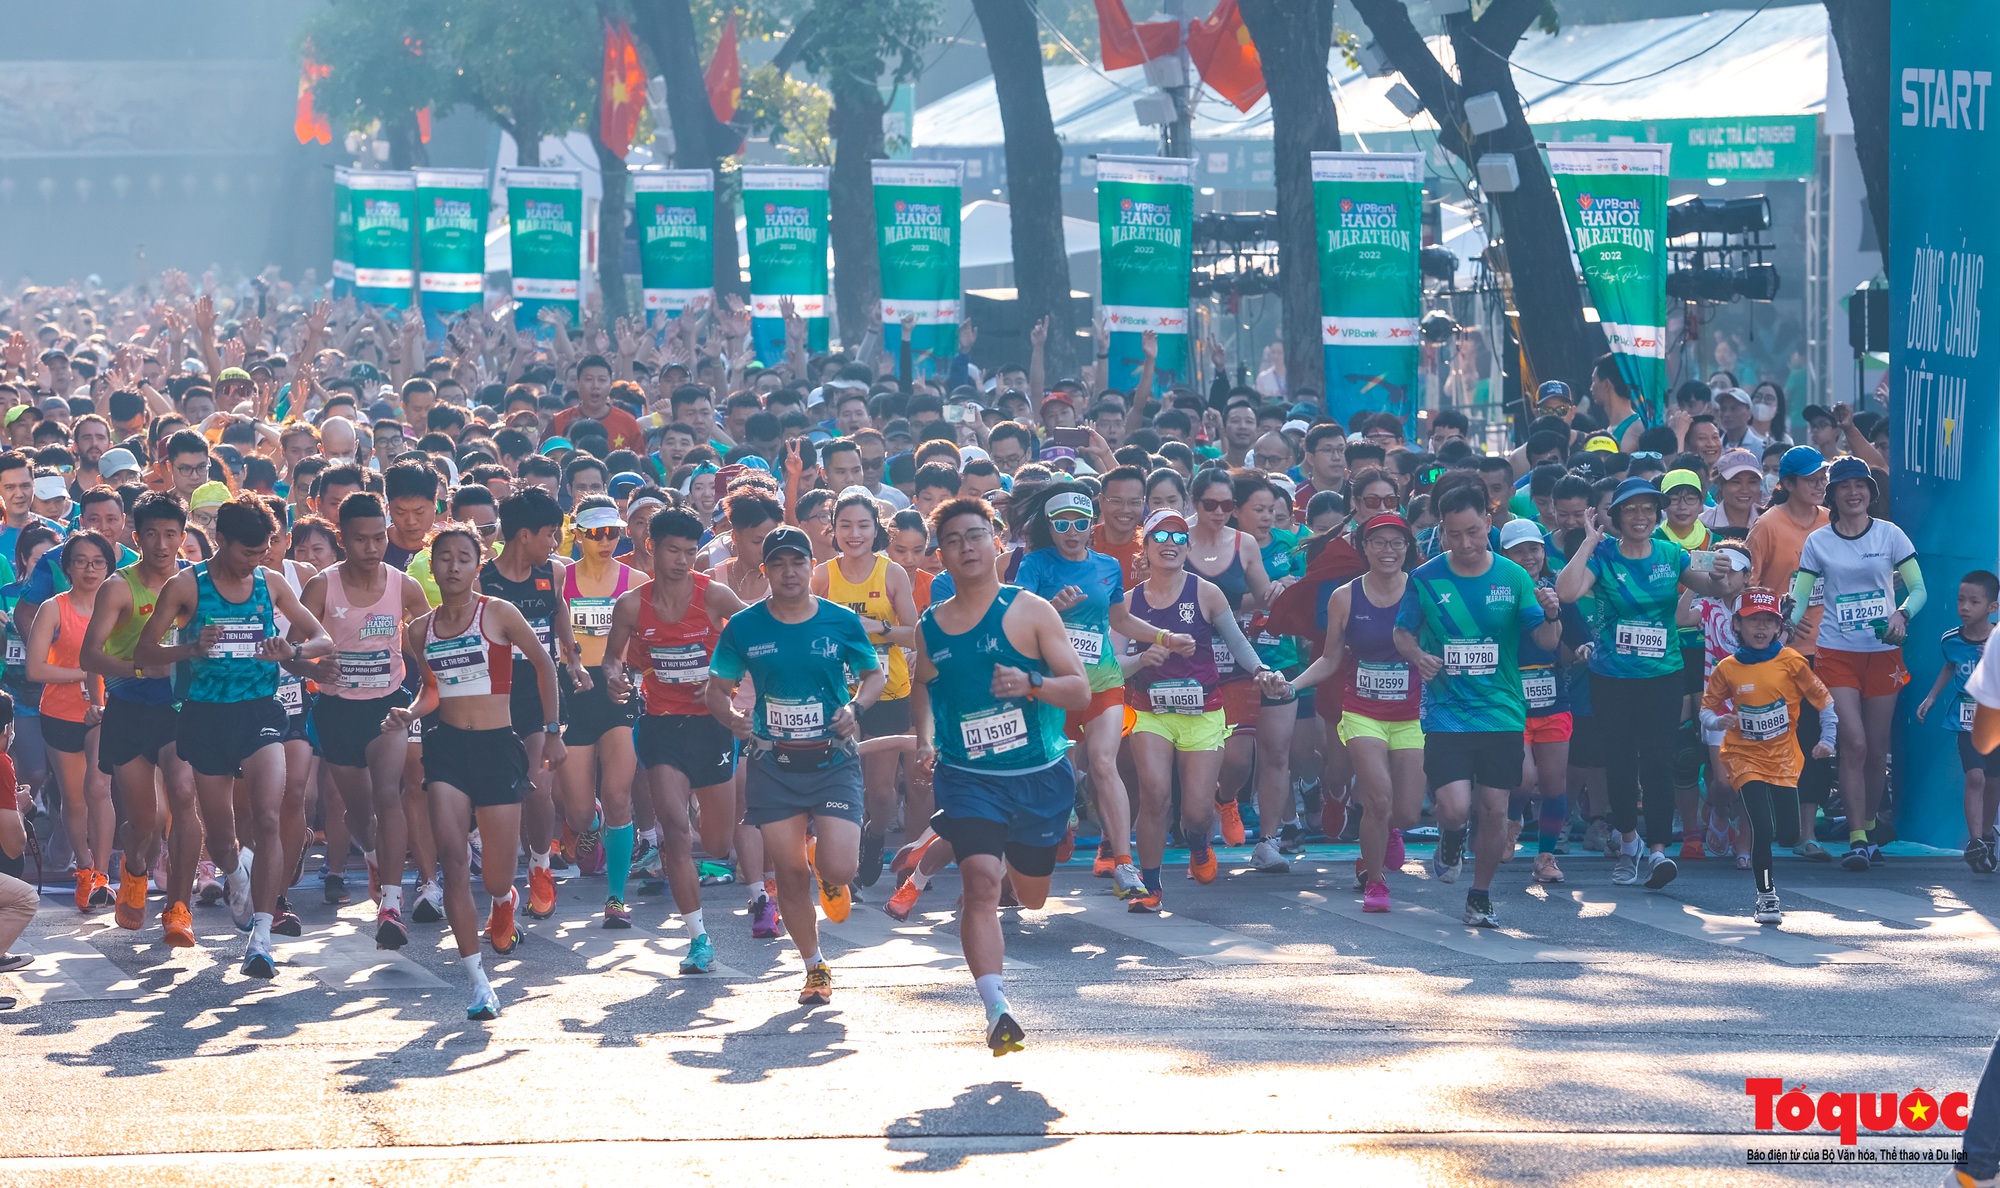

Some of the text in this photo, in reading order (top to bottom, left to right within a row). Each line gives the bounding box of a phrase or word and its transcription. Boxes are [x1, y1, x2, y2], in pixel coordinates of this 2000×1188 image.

[1901, 68, 1992, 130] START
[1134, 203, 1171, 212] VPBank
[1356, 204, 1397, 213] VPBank
[1595, 199, 1640, 210] VPBank
[526, 208, 564, 219] HANOI
[656, 213, 697, 225] HANOI
[895, 212, 942, 225] HANOI
[1120, 211, 1171, 226] HANOI
[1580, 210, 1640, 226] HANOI
[765, 214, 809, 226] HANOI
[1341, 213, 1397, 228] HANOI
[516, 218, 573, 237] MARATHON
[647, 225, 707, 243] MARATHON
[755, 227, 817, 246] MARATHON
[884, 226, 951, 246] MARATHON
[1111, 226, 1182, 248] MARATHON
[1328, 229, 1410, 253] MARATHON
[911, 244, 929, 252] 2022
[1134, 246, 1154, 254] 2022
[1359, 251, 1381, 259] 2022
[1600, 251, 1622, 260] 2022
[1945, 237, 1984, 358] SÁNG
[1341, 329, 1377, 338] VPBank
[1905, 358, 1933, 485] VIỆT
[1749, 593, 1775, 602] HANOI
[1855, 605, 1884, 618] 22479
[367, 620, 394, 628] HANOI
[1635, 634, 1662, 646] 19896
[457, 656, 470, 664] BICH
[1465, 652, 1493, 663] 19780
[1360, 675, 1404, 688] M 12599
[1525, 685, 1553, 697] 15555
[1170, 694, 1199, 705] 10581
[771, 711, 819, 726] M 13544
[1756, 714, 1785, 731] 18888
[967, 720, 1017, 745] M 15187
